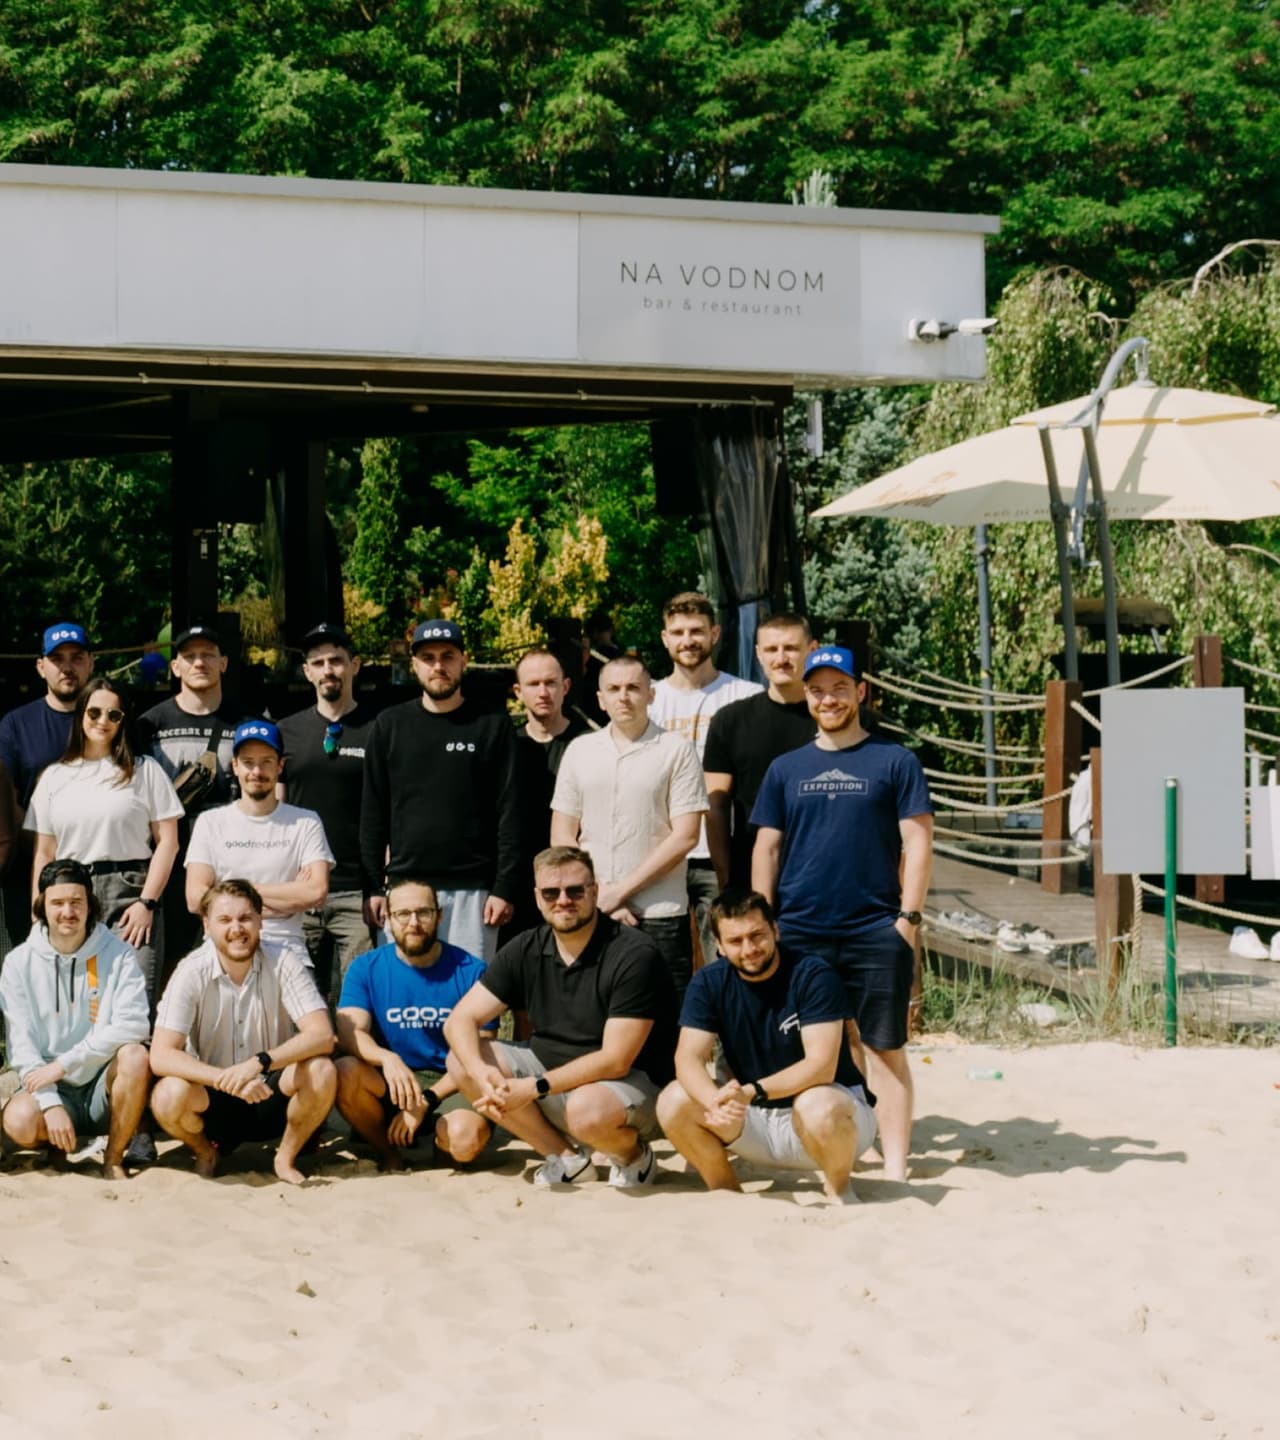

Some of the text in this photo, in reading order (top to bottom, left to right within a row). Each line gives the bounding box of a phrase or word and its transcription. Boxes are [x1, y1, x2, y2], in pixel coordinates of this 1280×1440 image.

[620, 261, 824, 292] NA VODNOM
[643, 297, 802, 316] bar & restaurant
[803, 782, 863, 792] EXPEDITION
